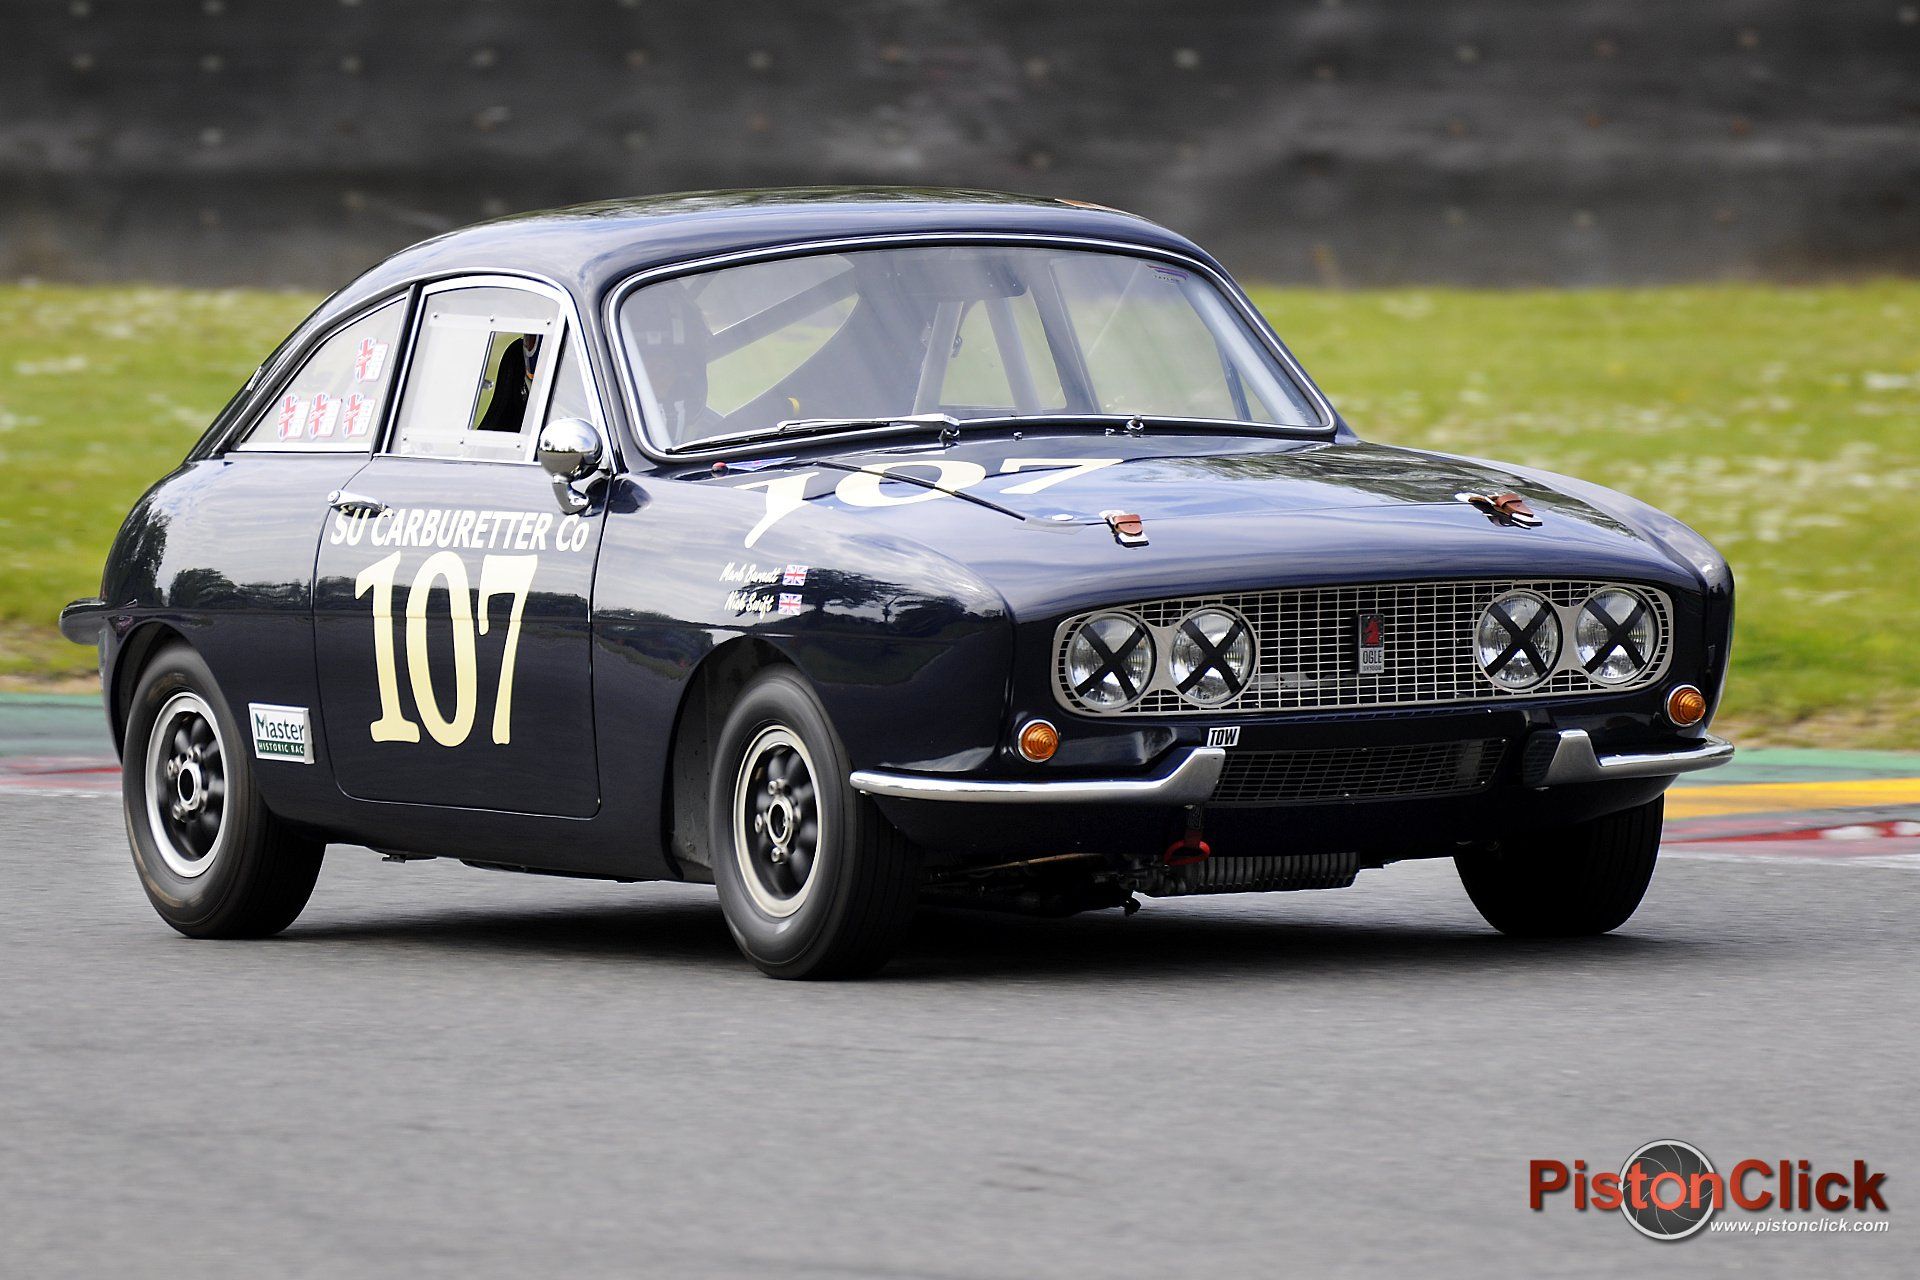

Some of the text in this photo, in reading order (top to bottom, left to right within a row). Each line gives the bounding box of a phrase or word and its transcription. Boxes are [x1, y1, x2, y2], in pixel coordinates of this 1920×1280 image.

[731, 458, 1124, 549] 107
[330, 508, 590, 552] SU CARBURETTER Co
[355, 551, 538, 747] 107
[1362, 650, 1382, 664] OGLE
[255, 713, 304, 741] Master
[1210, 728, 1238, 746] TOW
[258, 742, 289, 753] HISTORIC
